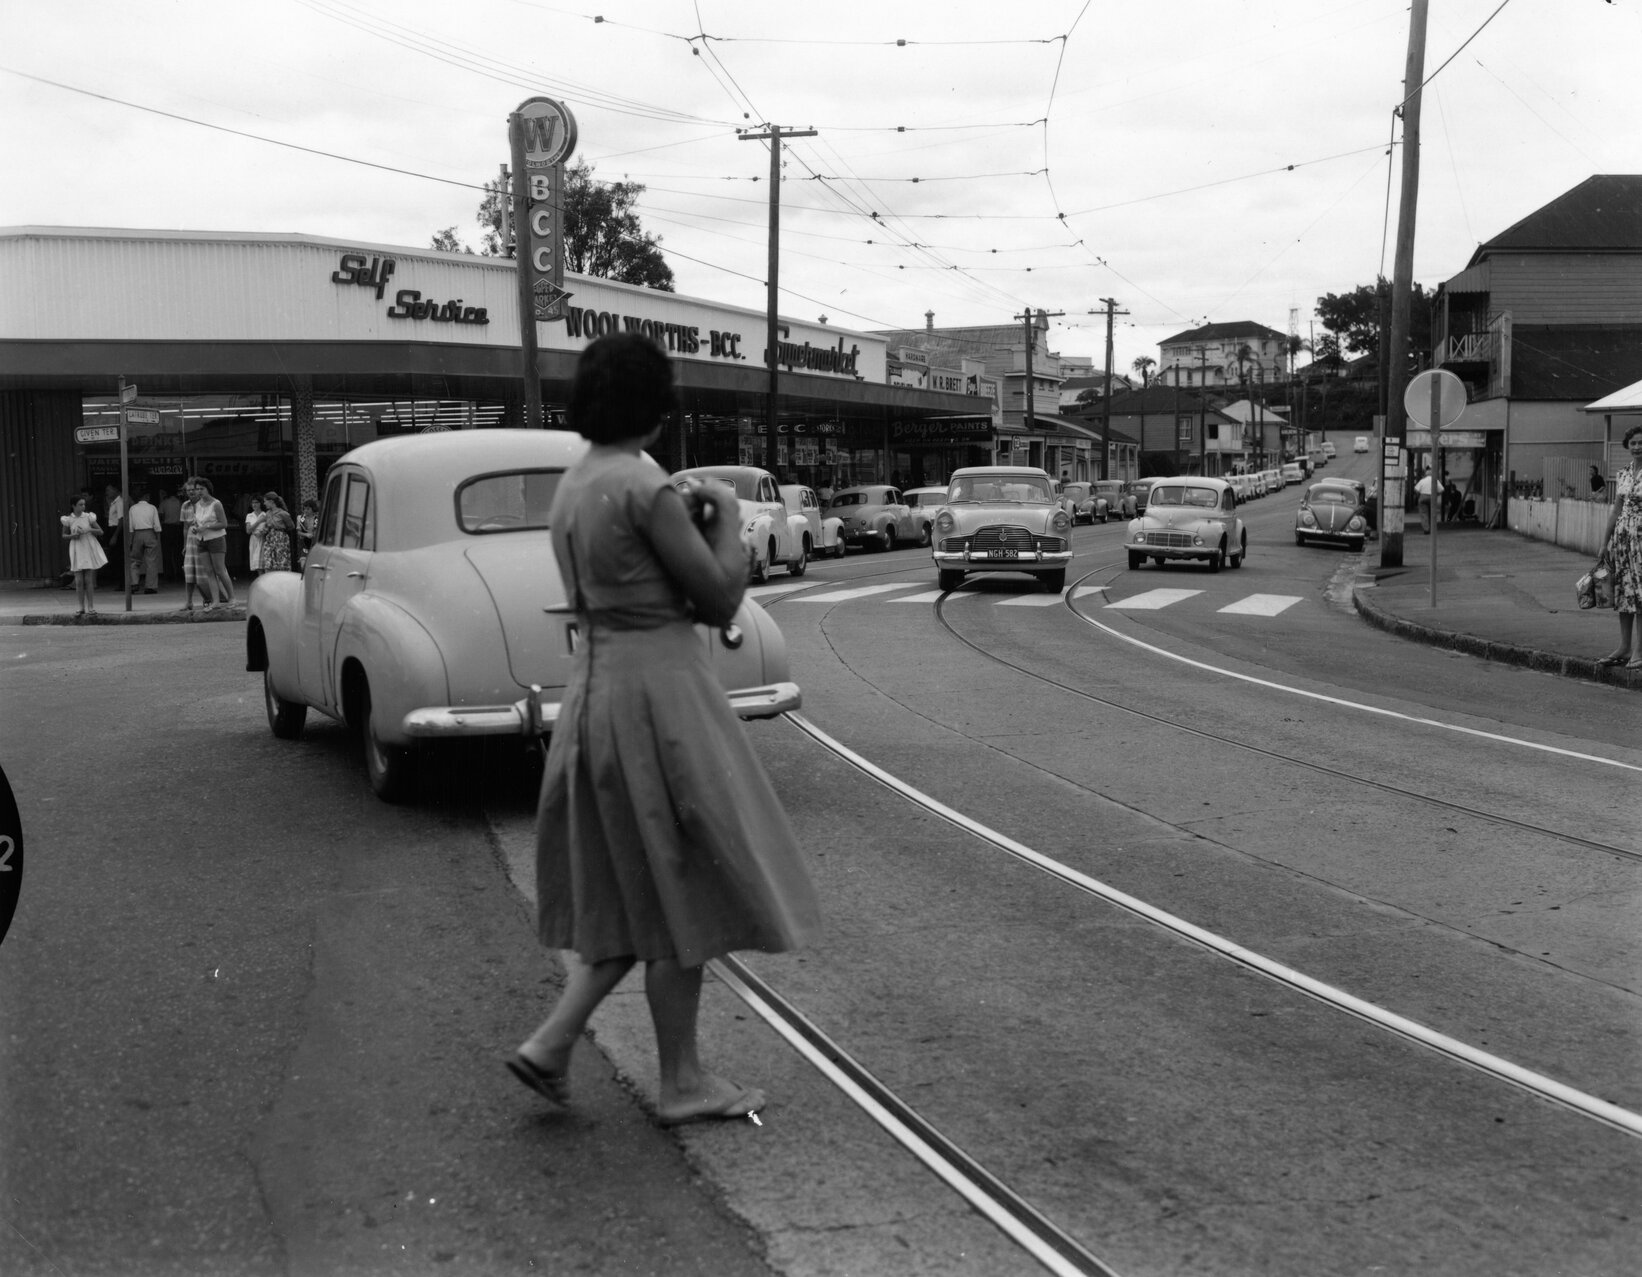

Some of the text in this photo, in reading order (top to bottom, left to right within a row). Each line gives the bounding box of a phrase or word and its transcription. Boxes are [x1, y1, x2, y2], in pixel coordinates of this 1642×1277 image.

[523, 115, 559, 153] W
[332, 254, 396, 299] Self
[387, 289, 489, 325] Service
[80, 429, 99, 437] GIVEN
[892, 420, 988, 438] Berger PAINTS
[205, 462, 249, 474] Candy
